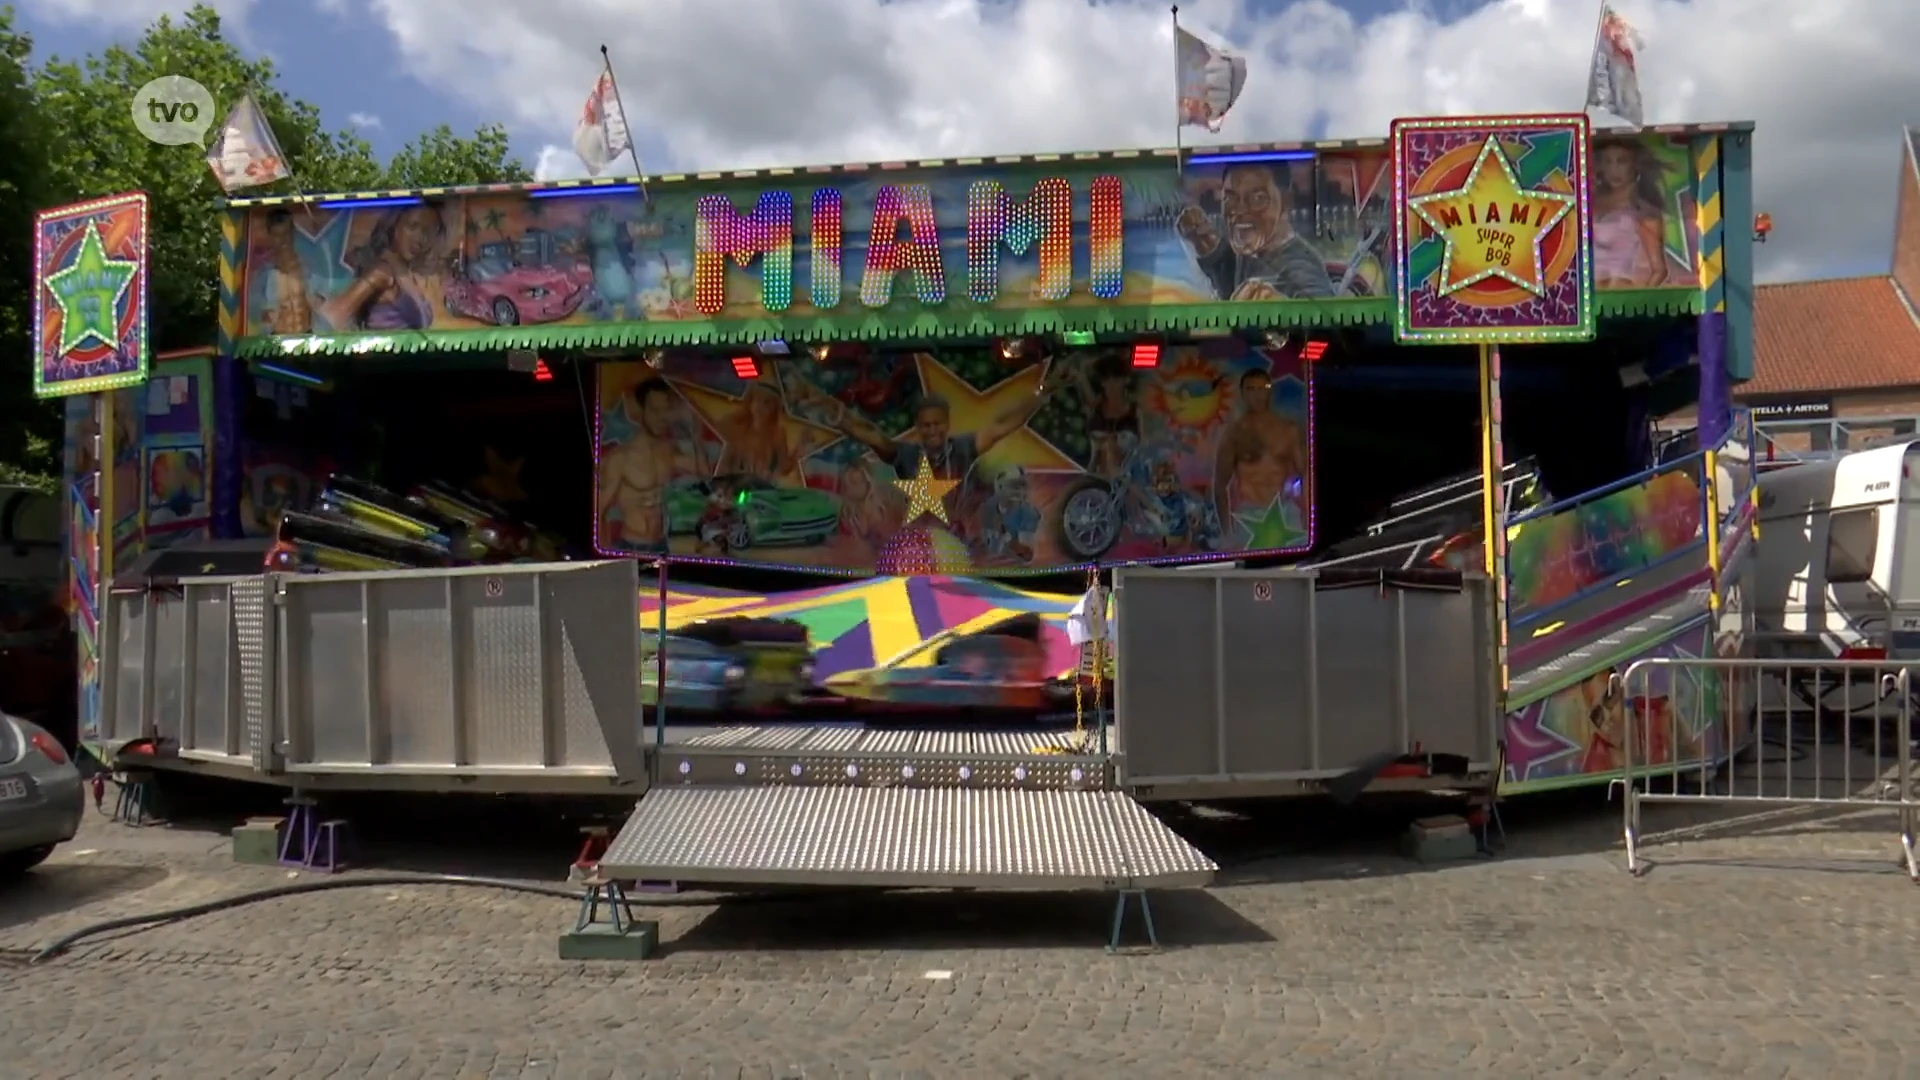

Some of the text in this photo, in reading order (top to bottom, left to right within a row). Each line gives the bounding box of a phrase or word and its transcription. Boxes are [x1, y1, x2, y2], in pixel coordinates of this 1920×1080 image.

[1440, 202, 1547, 229] MIAMI
[694, 174, 1123, 314] MIAMI
[1476, 228, 1515, 250] SUPER
[1485, 247, 1511, 267] BOB
[1793, 403, 1829, 413] ARTOIS
